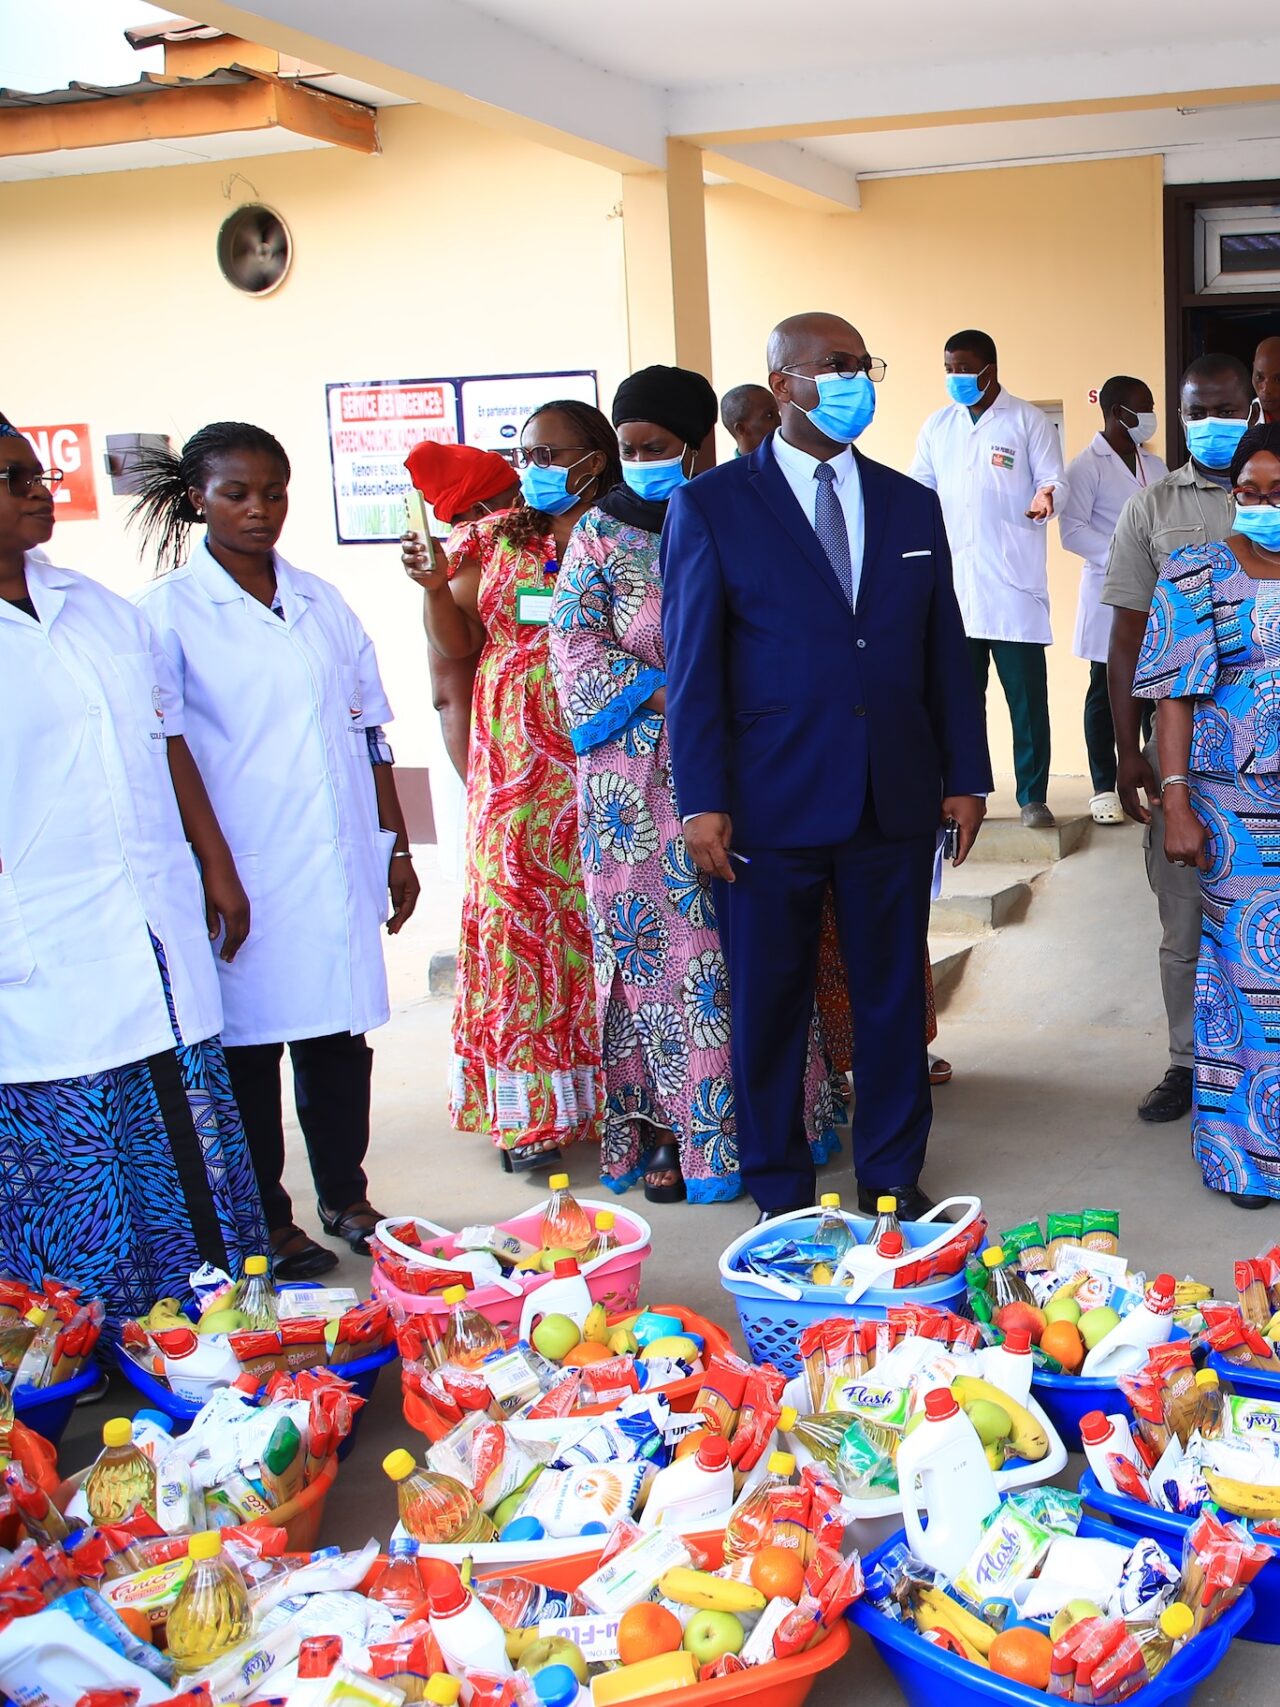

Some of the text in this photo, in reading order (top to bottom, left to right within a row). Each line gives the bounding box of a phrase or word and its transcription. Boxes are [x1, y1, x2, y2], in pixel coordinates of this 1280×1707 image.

[341, 393, 377, 419] SERVICE
[378, 392, 395, 418] DES
[842, 1386, 893, 1404] Flash
[977, 1527, 1019, 1584] Flash
[242, 1650, 275, 1686] Flash
